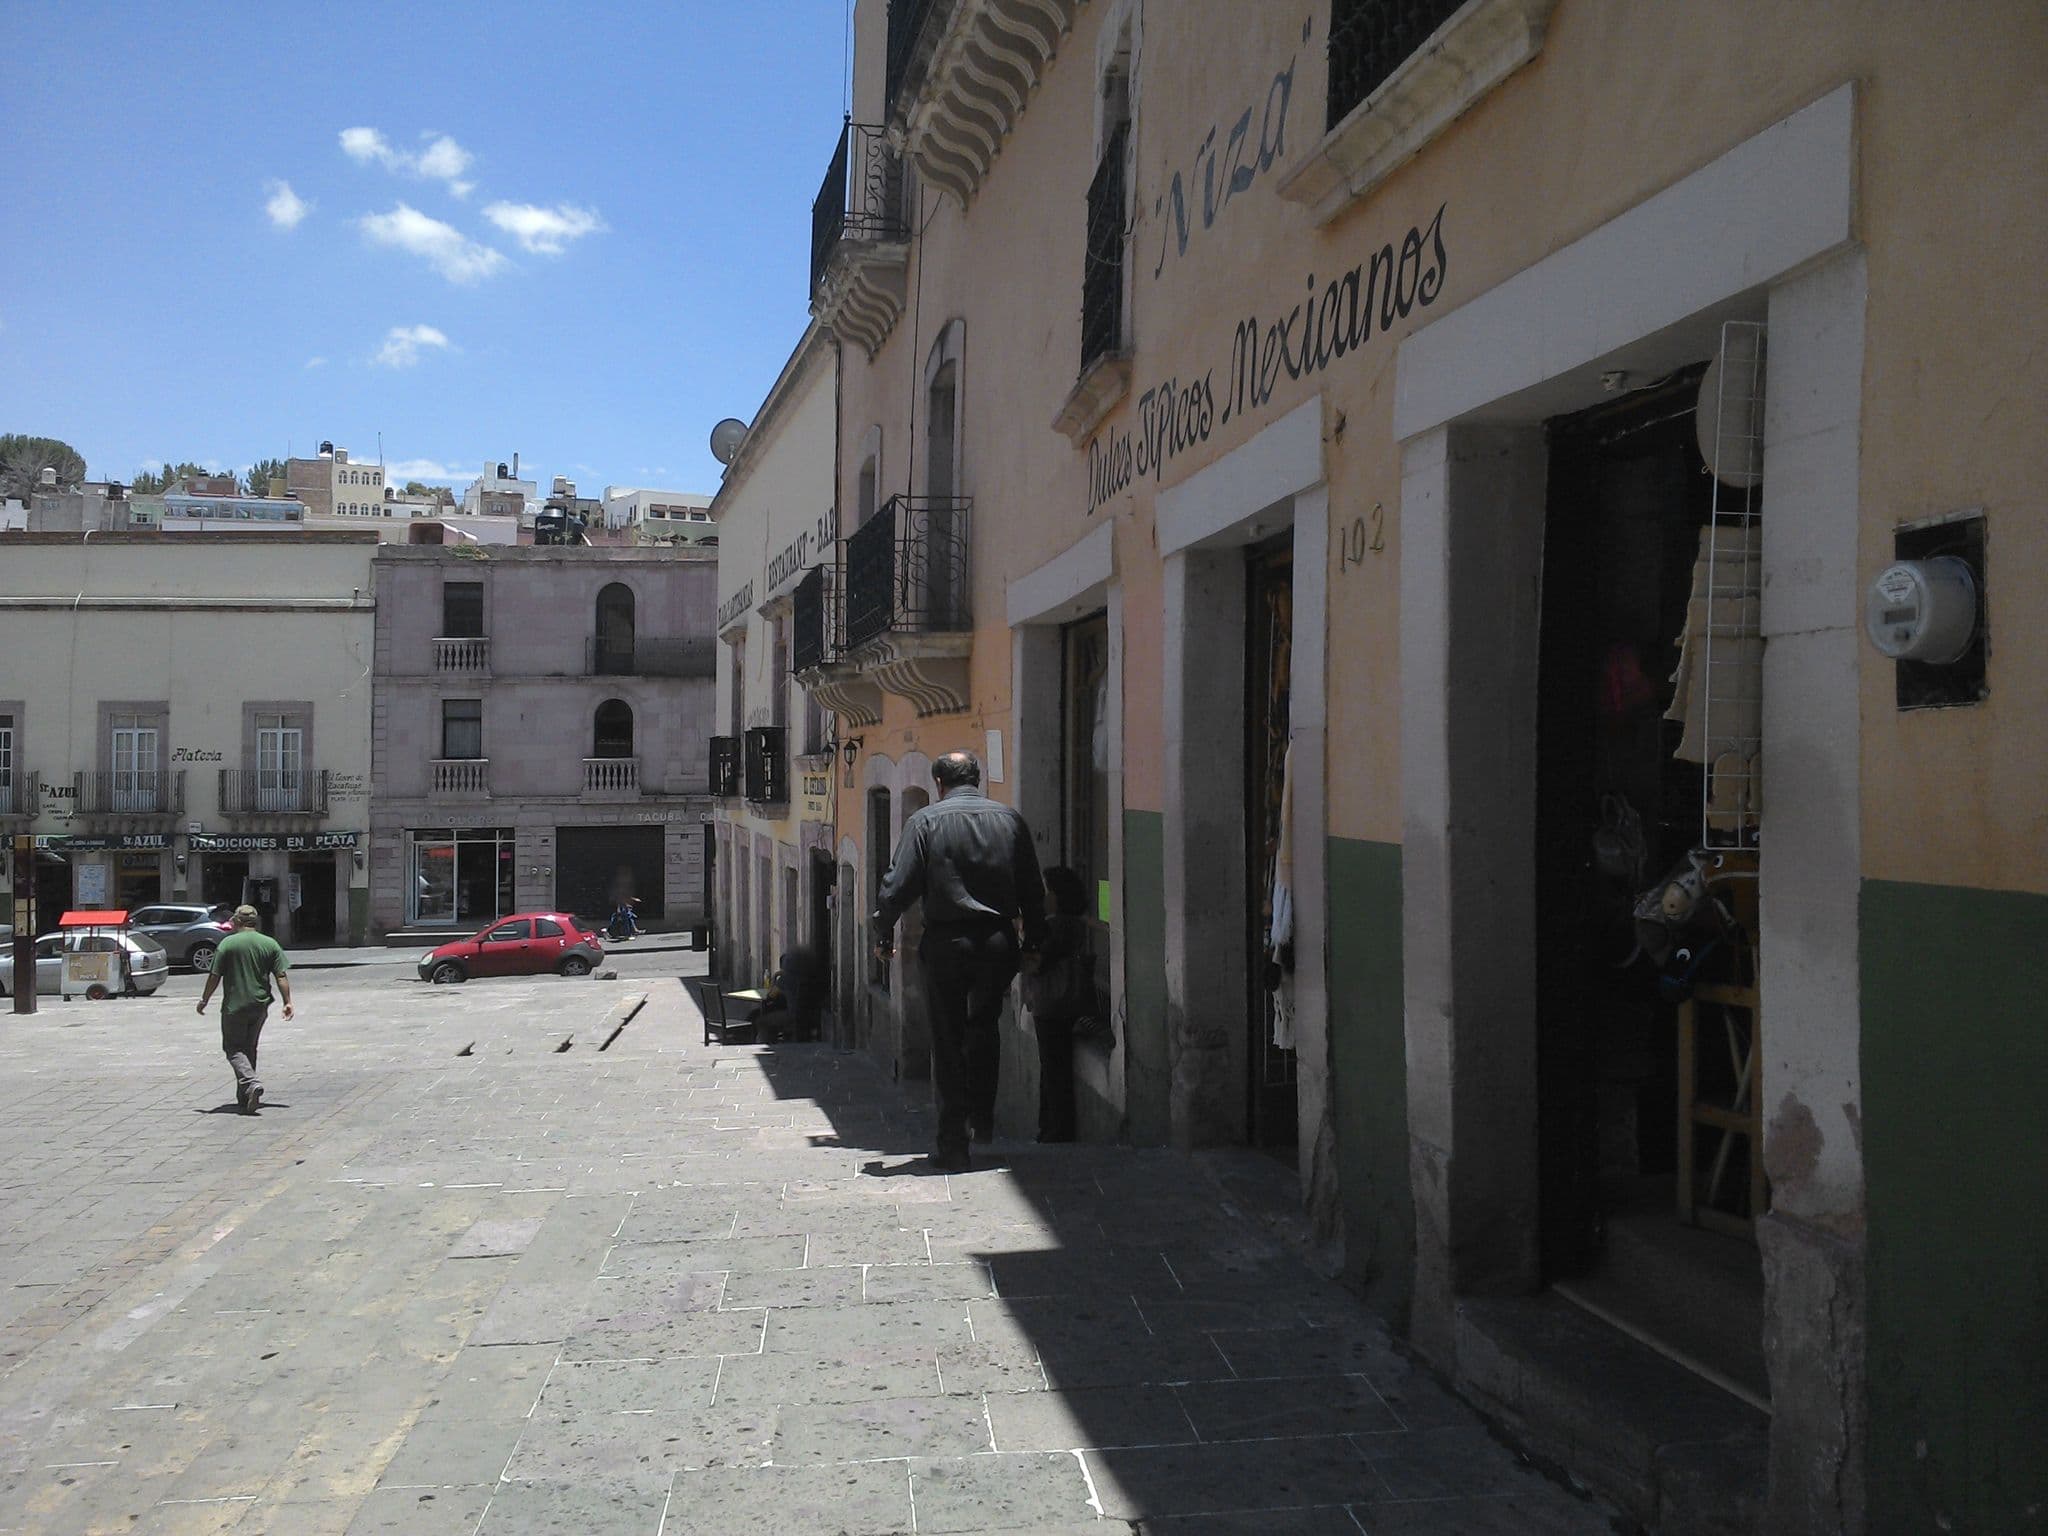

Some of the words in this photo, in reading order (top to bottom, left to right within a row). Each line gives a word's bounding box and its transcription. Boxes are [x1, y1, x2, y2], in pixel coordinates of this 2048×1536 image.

[1087, 426, 1133, 516] Dulces
[1223, 201, 1448, 425] Mexicanos
[1340, 503, 1385, 573] 102
[49, 786, 79, 798] AZUL
[134, 834, 166, 847] AZUL
[190, 837, 277, 848] TRADICIONES
[287, 837, 304, 847] EN
[315, 835, 356, 846] PLATA
